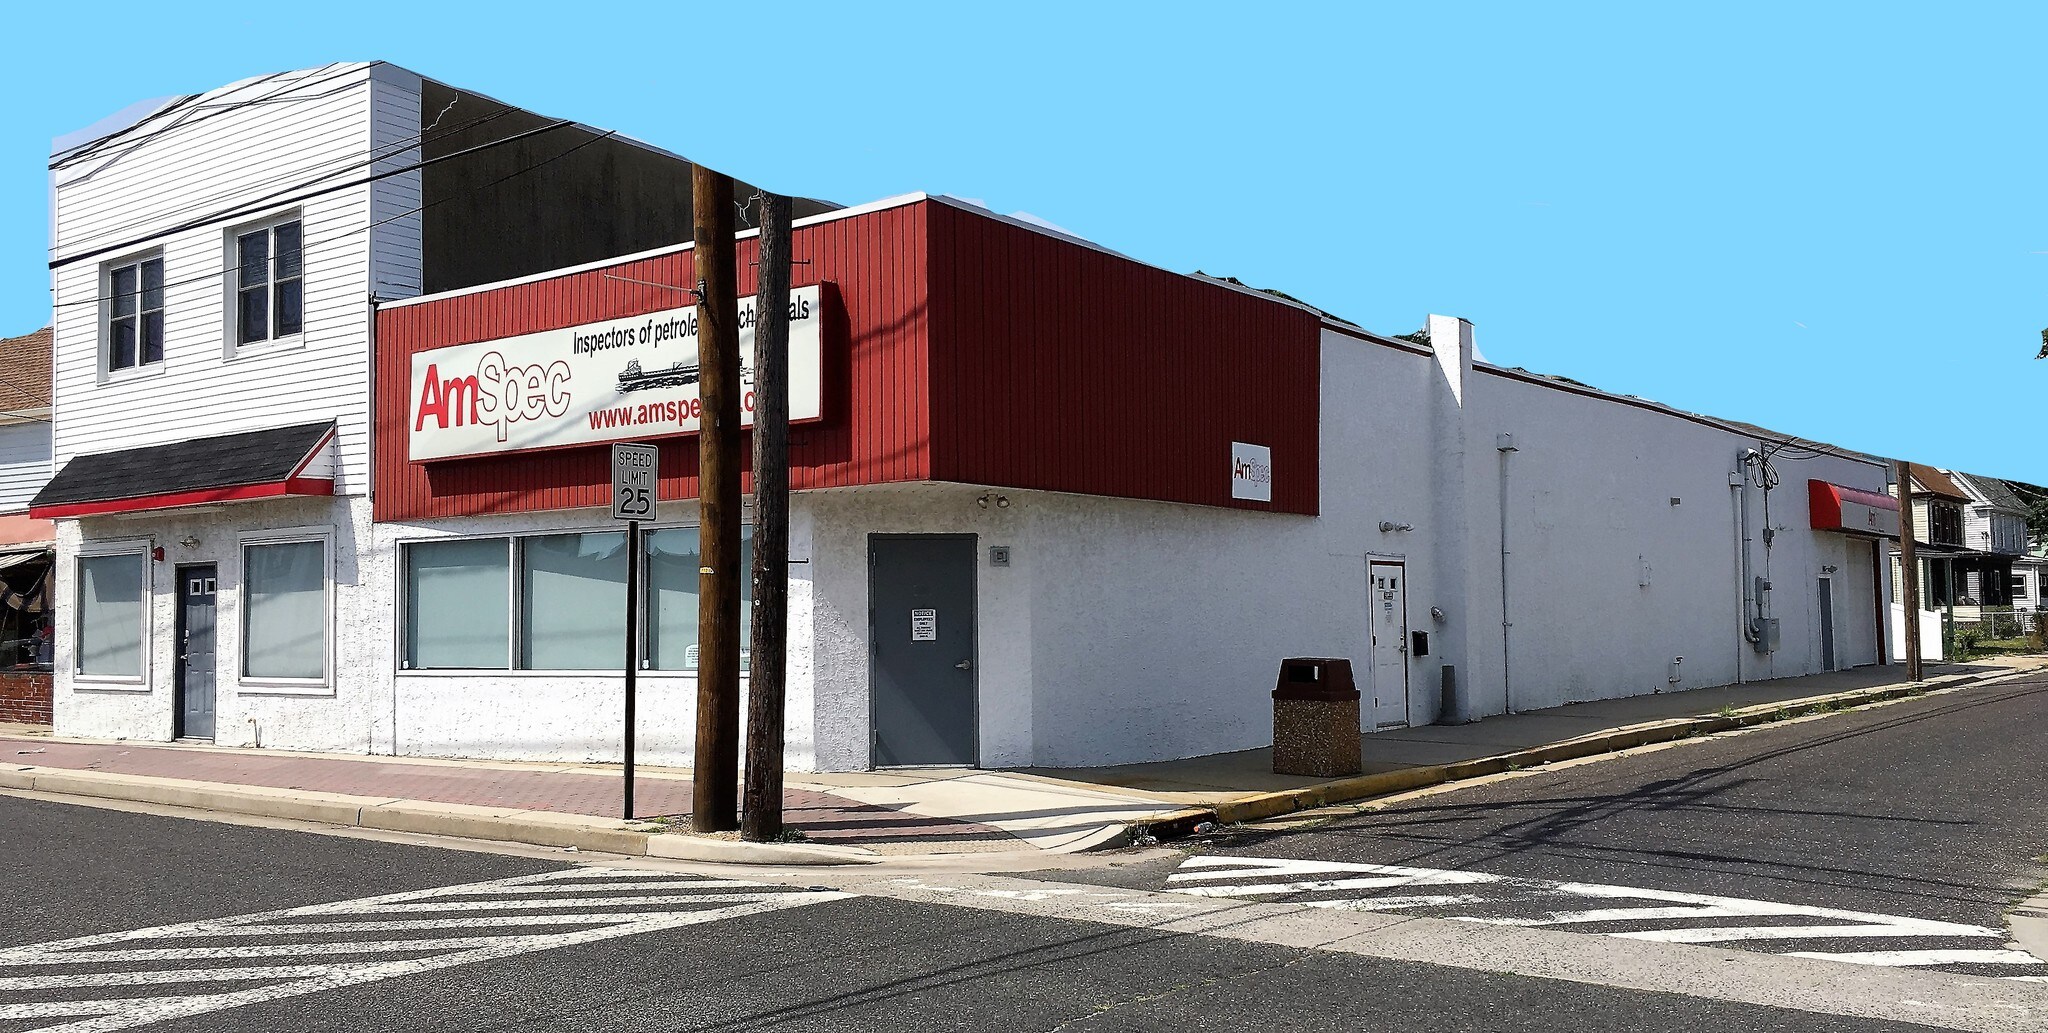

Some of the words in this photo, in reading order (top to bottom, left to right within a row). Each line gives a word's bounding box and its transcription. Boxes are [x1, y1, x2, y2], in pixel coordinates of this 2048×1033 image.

[573, 326, 636, 358] Inspectors
[639, 319, 653, 344] of
[654, 312, 699, 348] petrole
[415, 351, 572, 443] AmSpec
[618, 451, 652, 468] SPEED
[1234, 456, 1270, 488] AmSpec
[621, 470, 648, 486] LIMIT
[620, 487, 650, 515] 25
